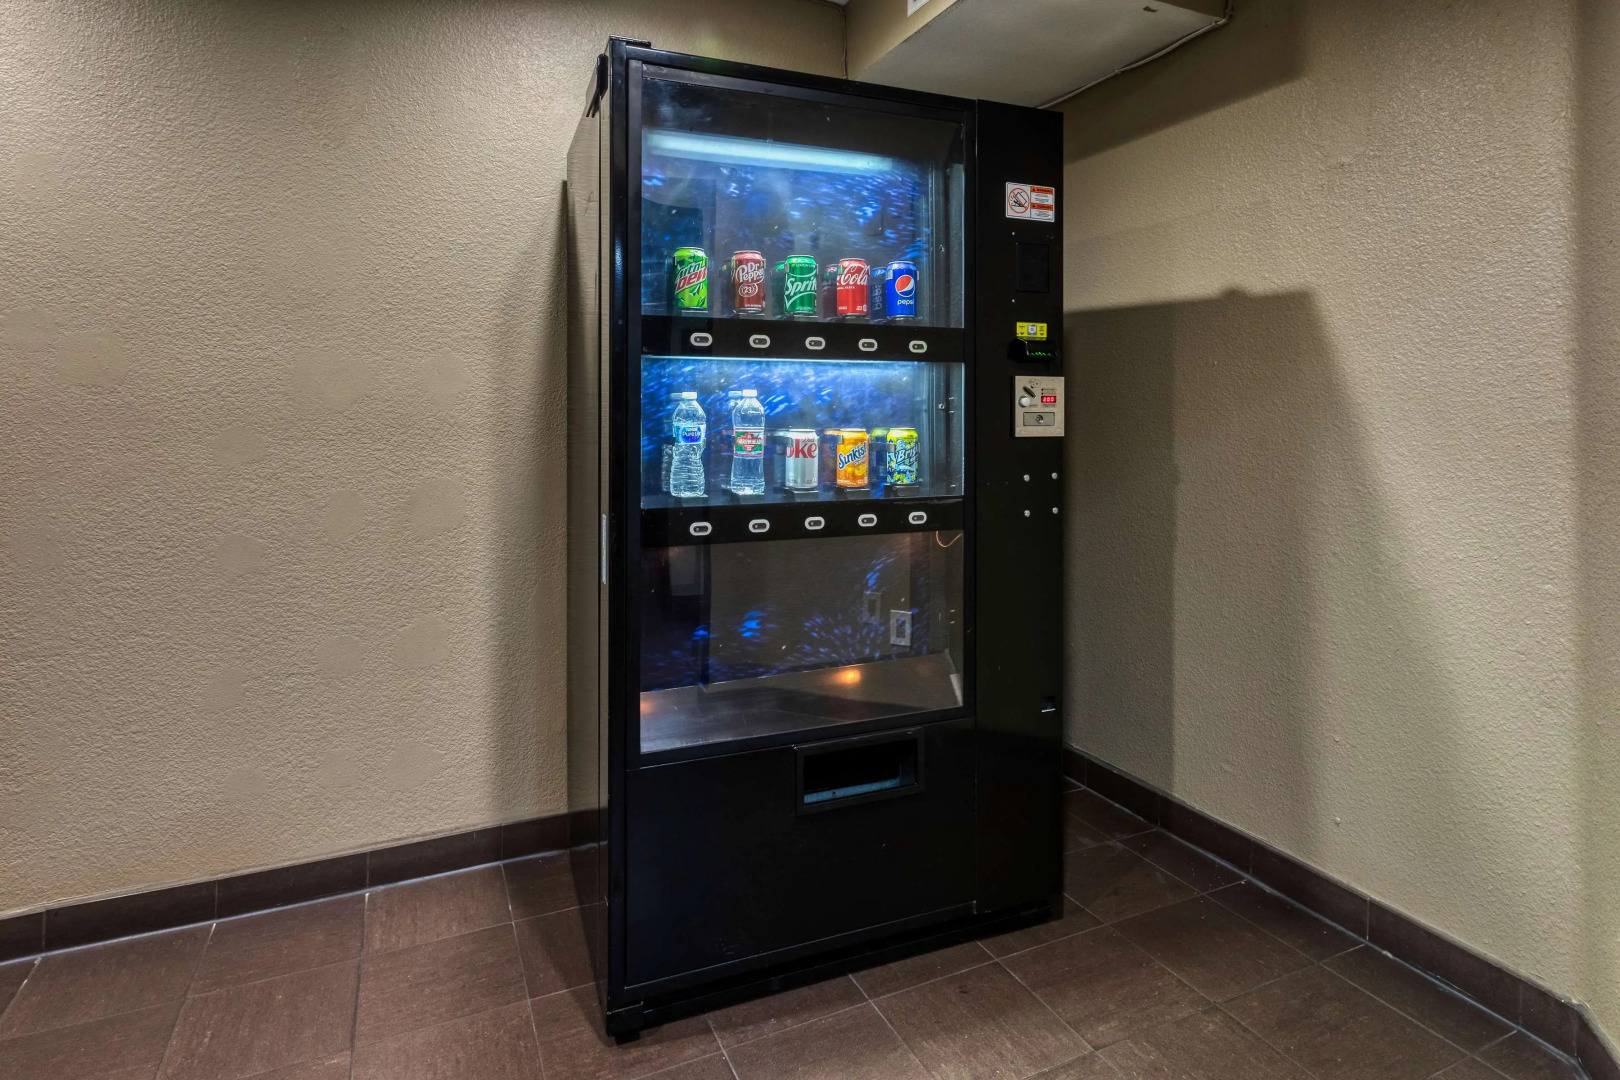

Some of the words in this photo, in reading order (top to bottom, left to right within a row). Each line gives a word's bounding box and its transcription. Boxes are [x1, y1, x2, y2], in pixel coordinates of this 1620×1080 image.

[748, 262, 760, 272] Dr
[785, 276, 817, 296] Sprit
[838, 441, 868, 470] Sunkist
